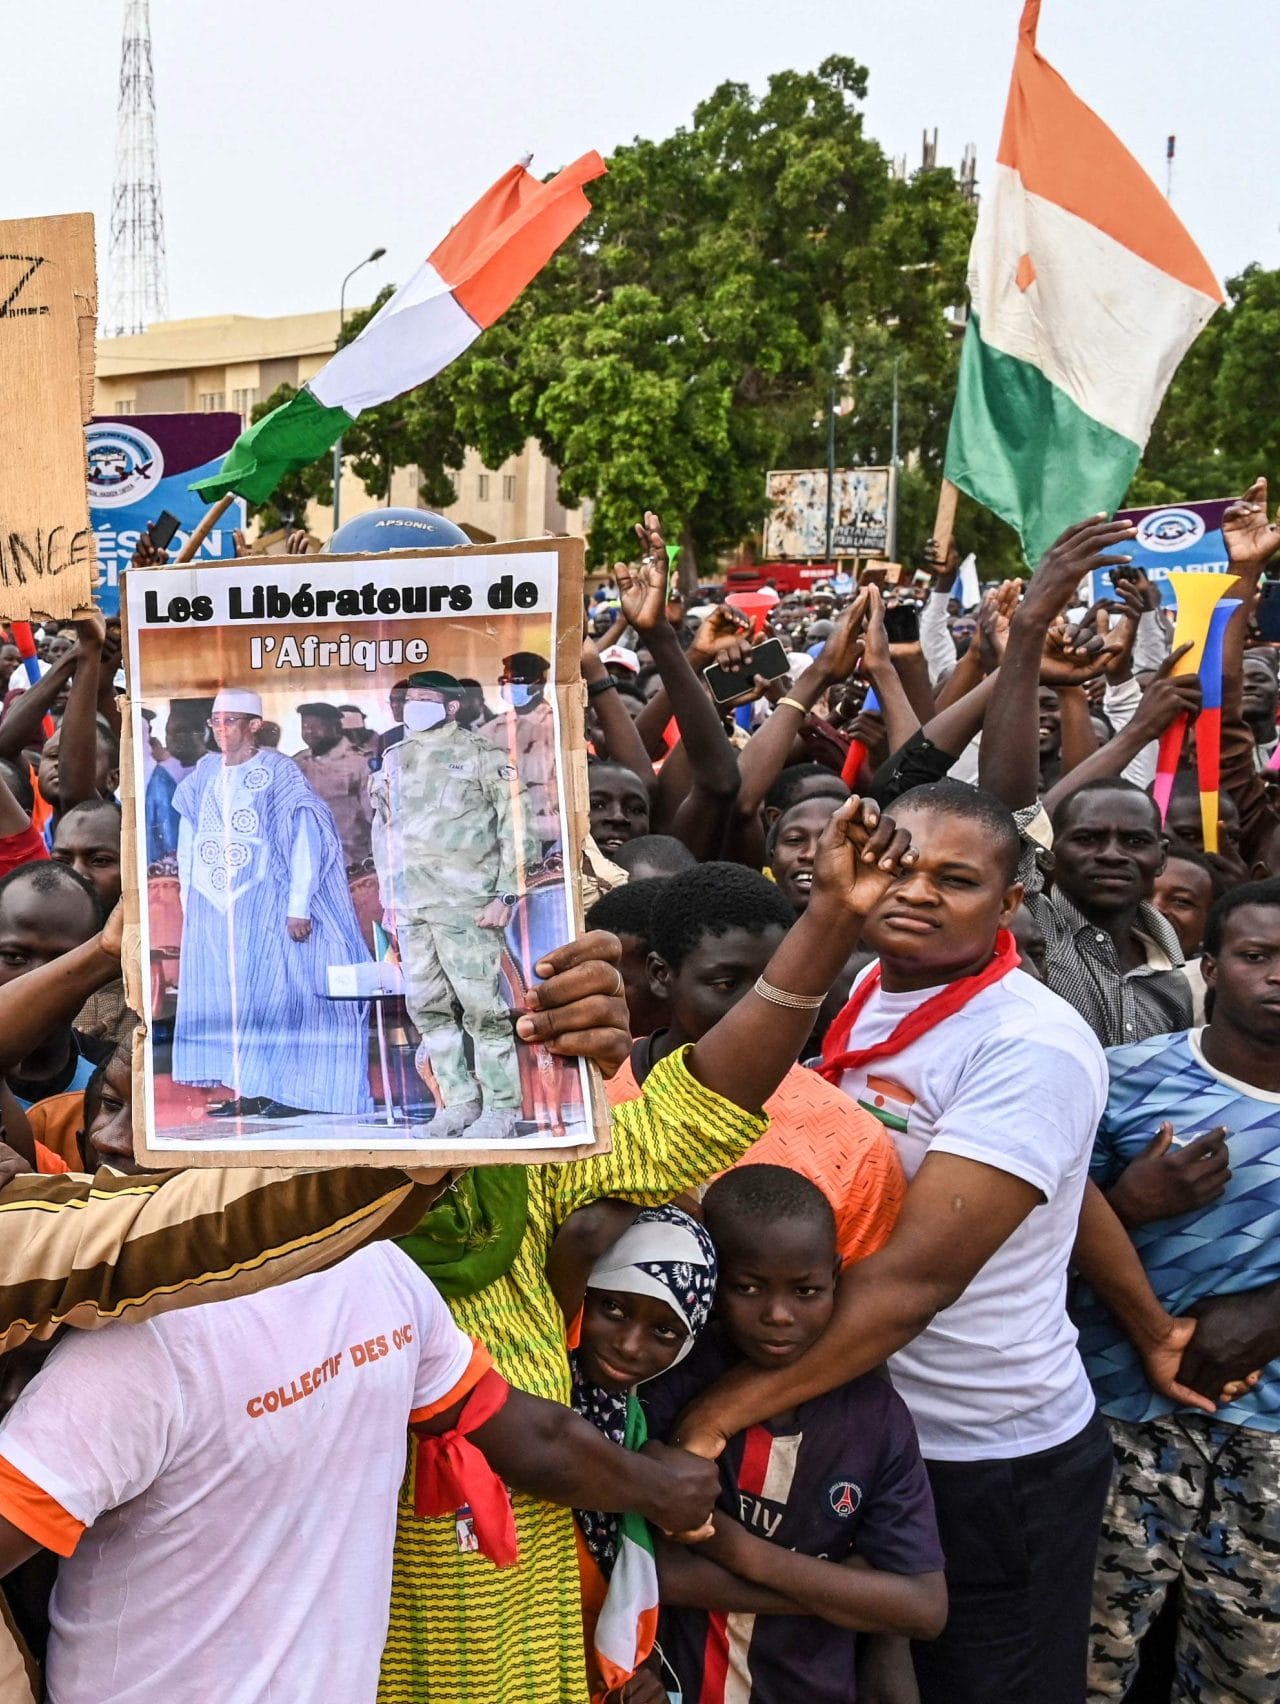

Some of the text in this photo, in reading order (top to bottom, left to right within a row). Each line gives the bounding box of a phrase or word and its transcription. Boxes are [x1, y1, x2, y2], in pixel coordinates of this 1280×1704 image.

[374, 519, 436, 532] APSONIC
[145, 575, 539, 623] Les Libérateurs de
[249, 633, 429, 673] l’Afrique
[246, 1352, 343, 1419] COLLECTIF
[349, 1335, 390, 1368] DES
